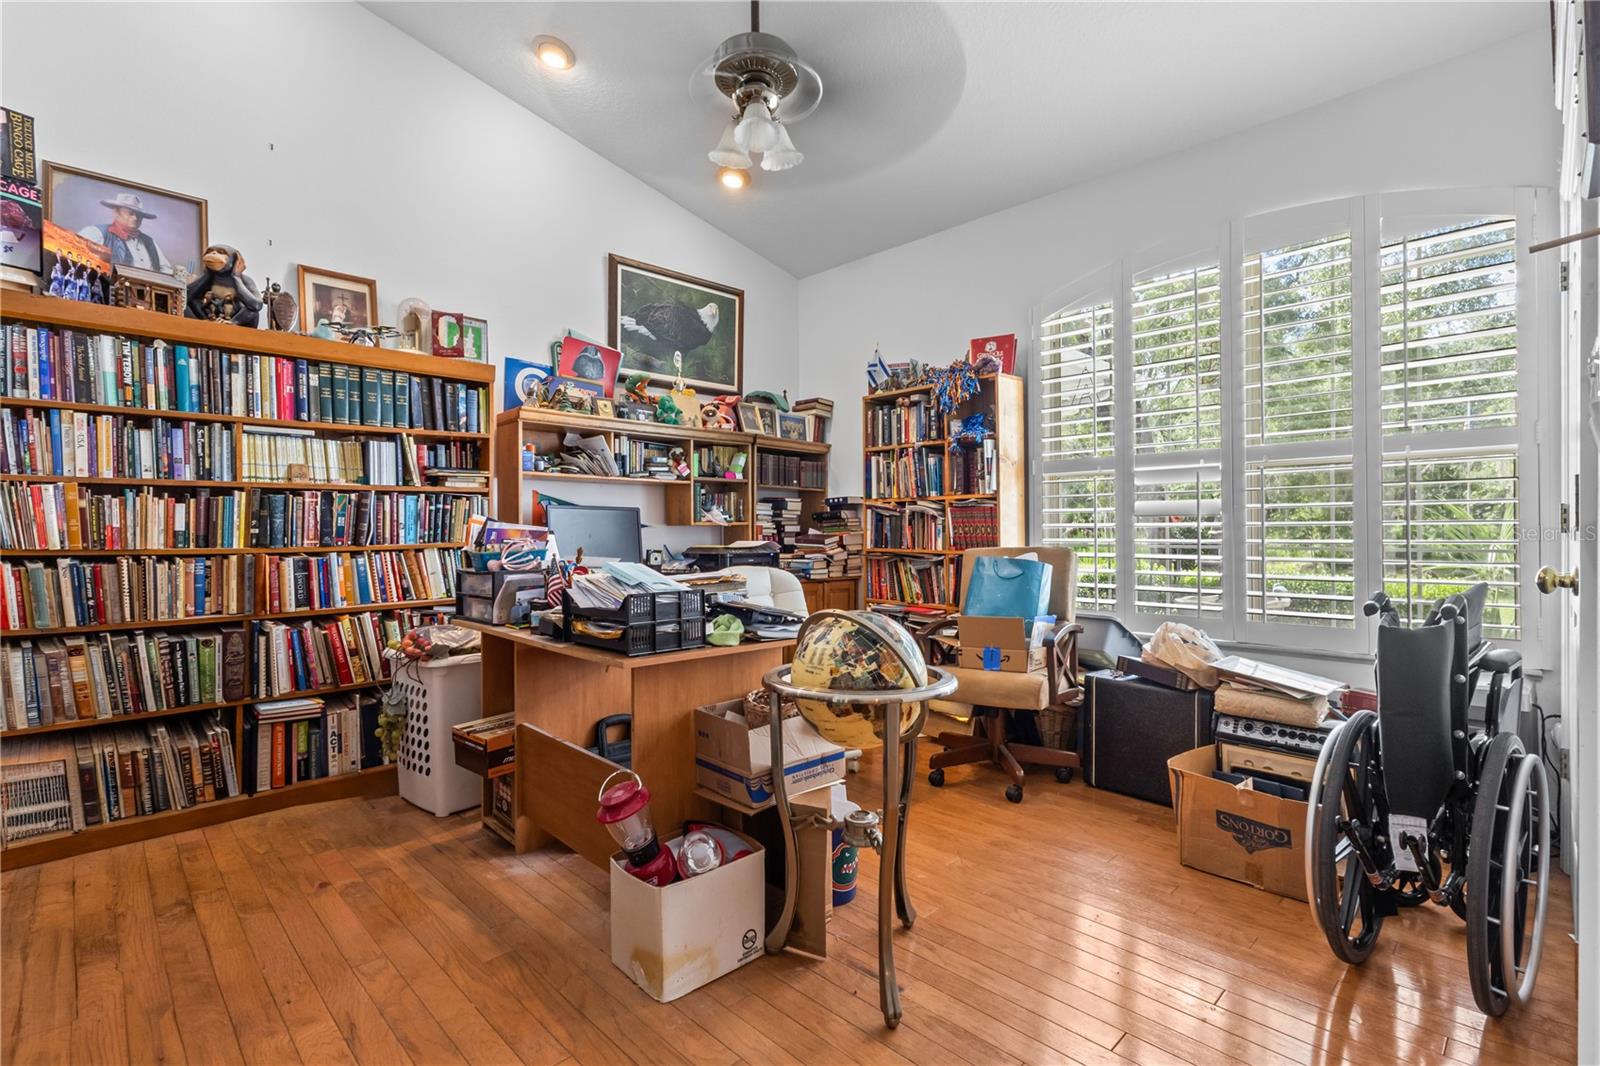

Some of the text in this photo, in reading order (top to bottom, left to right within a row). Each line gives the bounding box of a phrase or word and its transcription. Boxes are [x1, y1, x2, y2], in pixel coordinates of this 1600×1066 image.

[10, 111, 26, 179] BINGO CAGE
[24, 117, 36, 179] DELUXE METAL
[0, 180, 38, 201] CAGE
[121, 341, 133, 385] TIM TEBOW
[77, 433, 85, 449] USA
[1219, 814, 1289, 844] GORTONS
